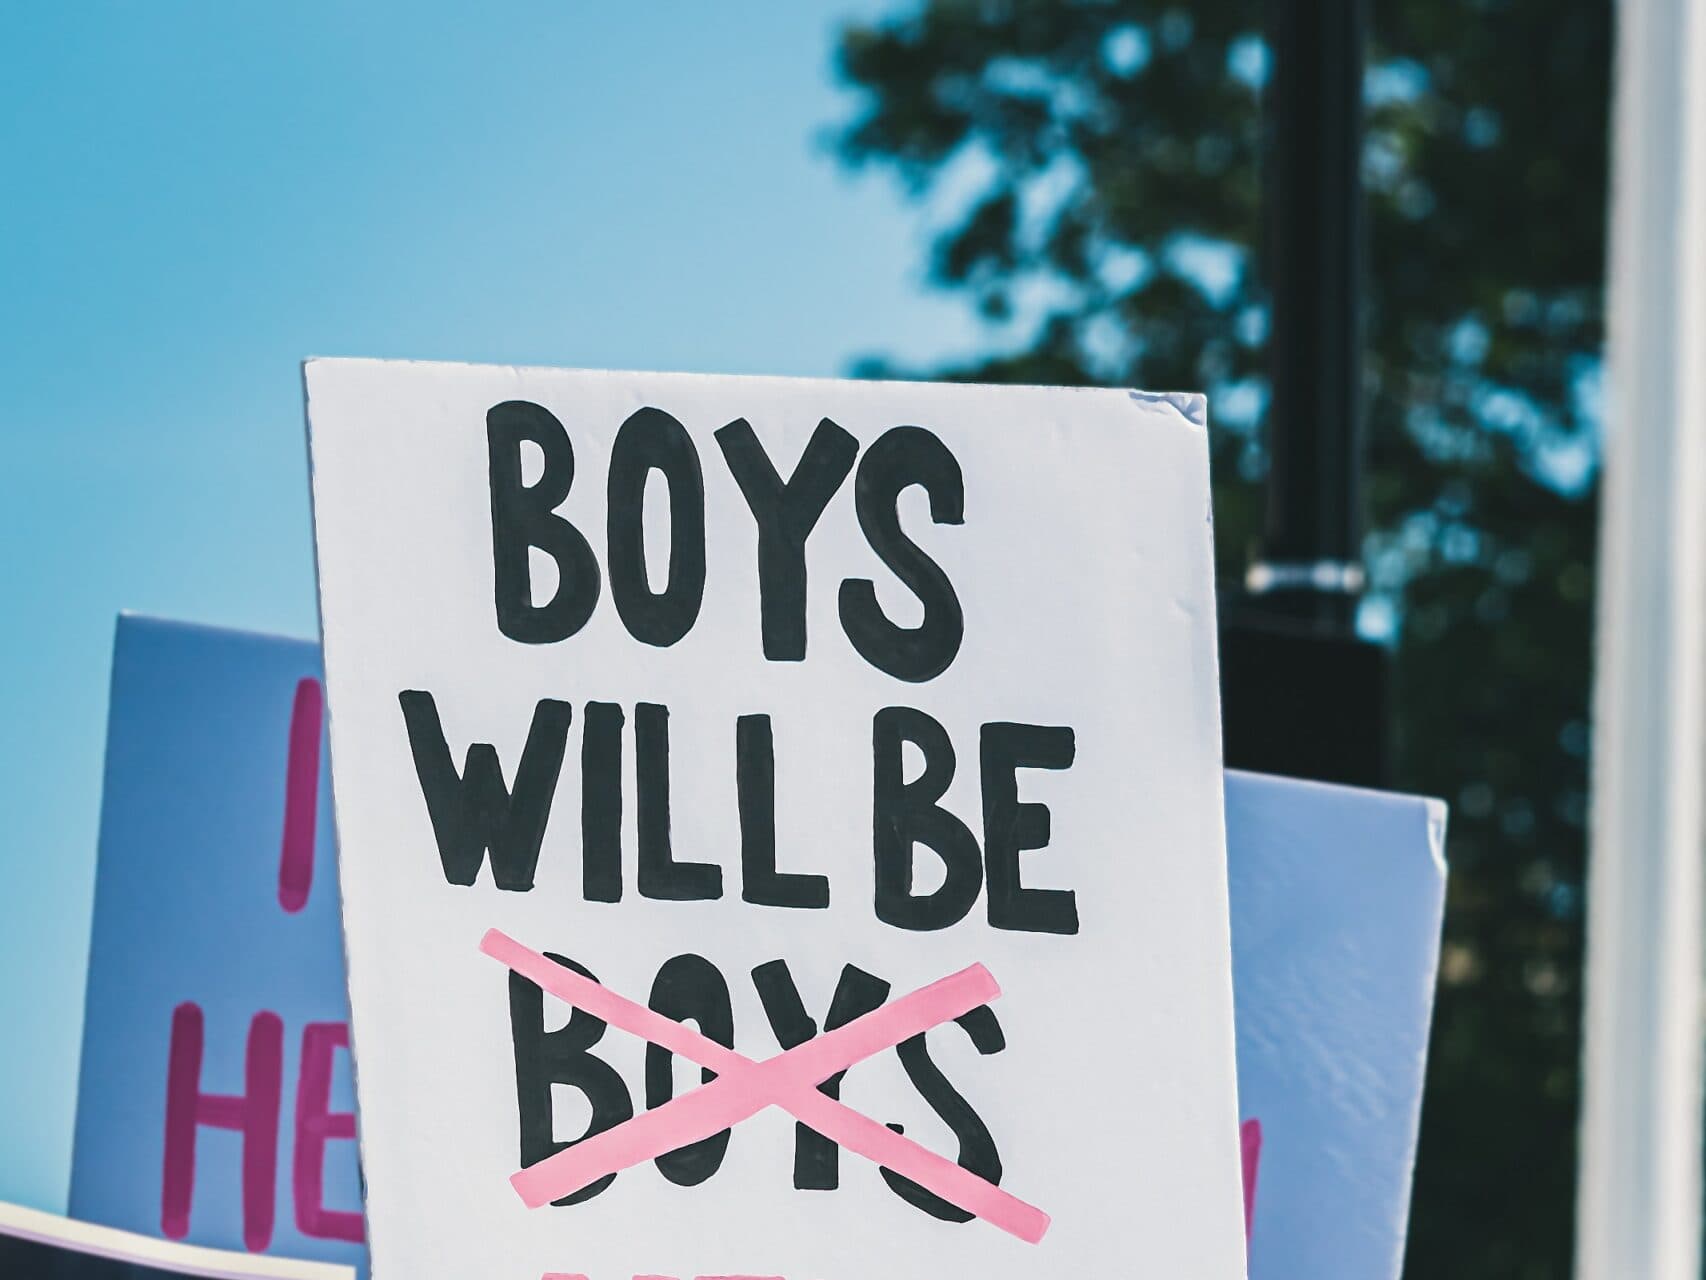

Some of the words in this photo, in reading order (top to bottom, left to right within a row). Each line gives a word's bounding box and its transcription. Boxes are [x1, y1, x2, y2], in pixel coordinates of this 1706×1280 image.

[487, 400, 965, 683] BOYS
[399, 690, 829, 908] WILL
[873, 706, 1079, 935] BE
[508, 952, 1006, 1223] BOYS
